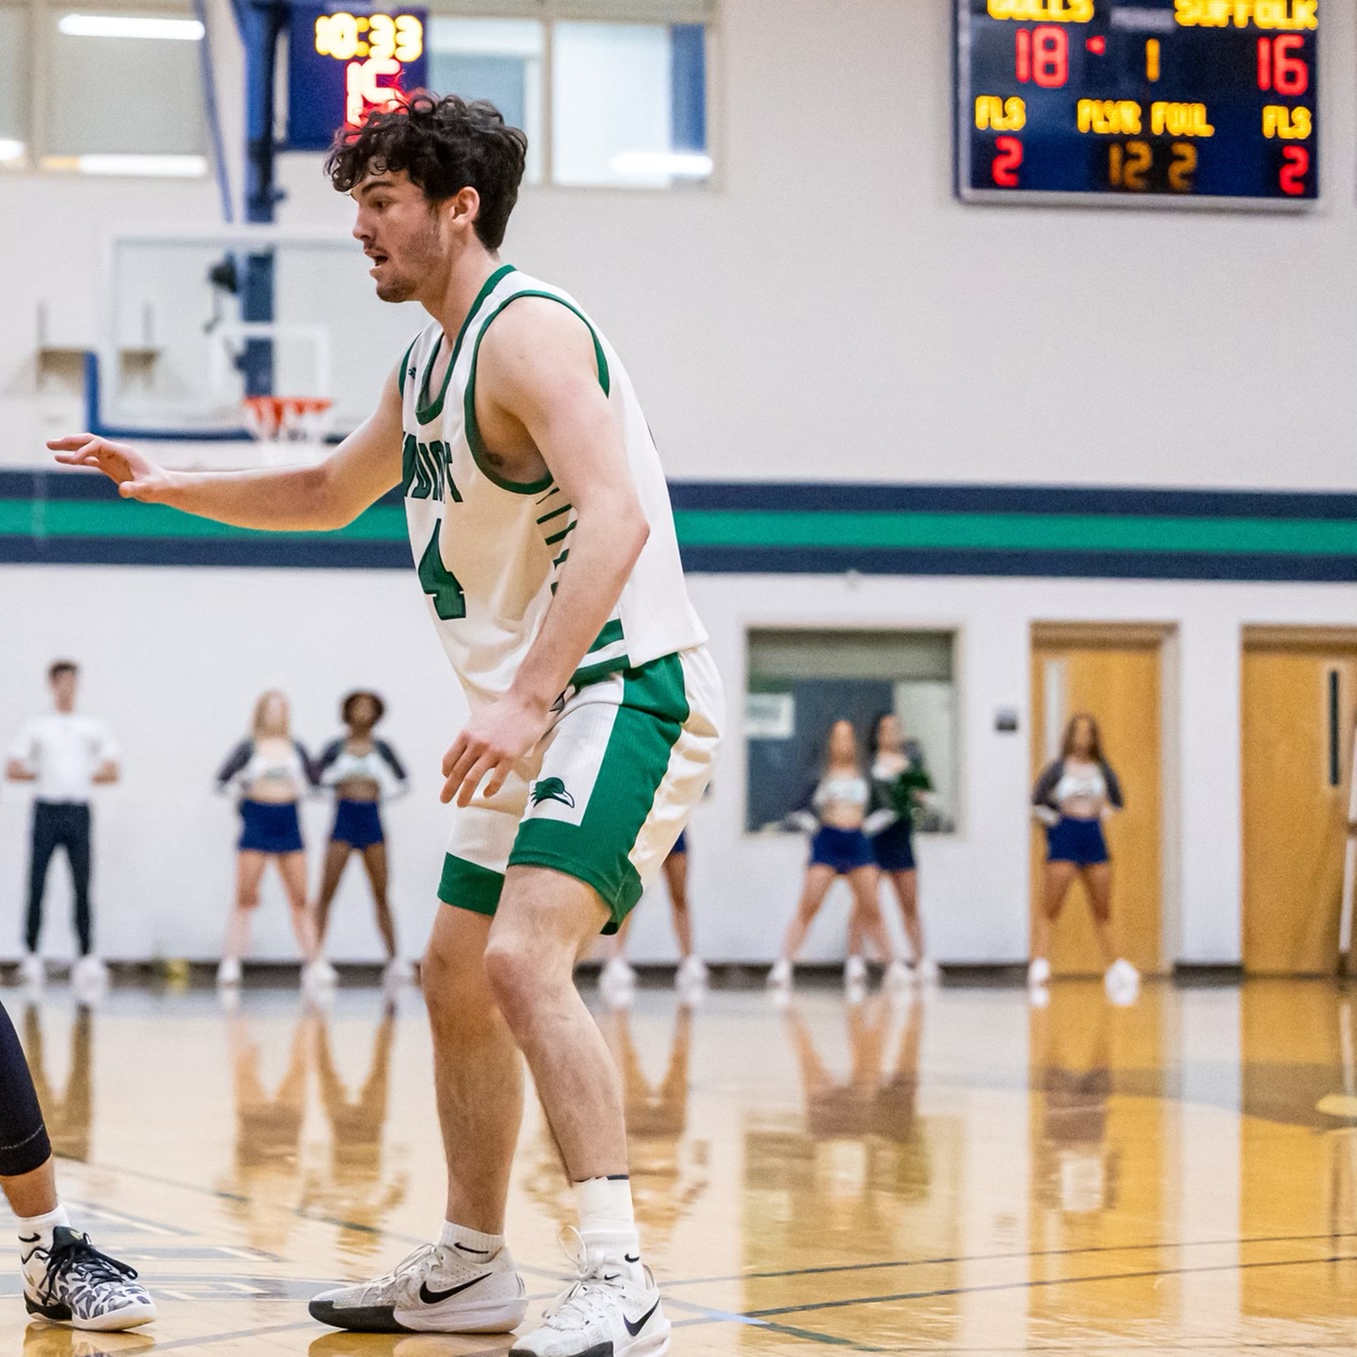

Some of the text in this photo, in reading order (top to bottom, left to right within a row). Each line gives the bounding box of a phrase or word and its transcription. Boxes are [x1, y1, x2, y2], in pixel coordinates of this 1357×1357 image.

[1015, 25, 1069, 88] 18
[1257, 33, 1309, 96] 16
[974, 95, 1027, 131] FLS
[1150, 101, 1215, 137] FOUL
[1262, 105, 1313, 139] FLS
[991, 136, 1024, 188] 2
[1279, 145, 1310, 195] 2
[417, 518, 467, 621] 4
